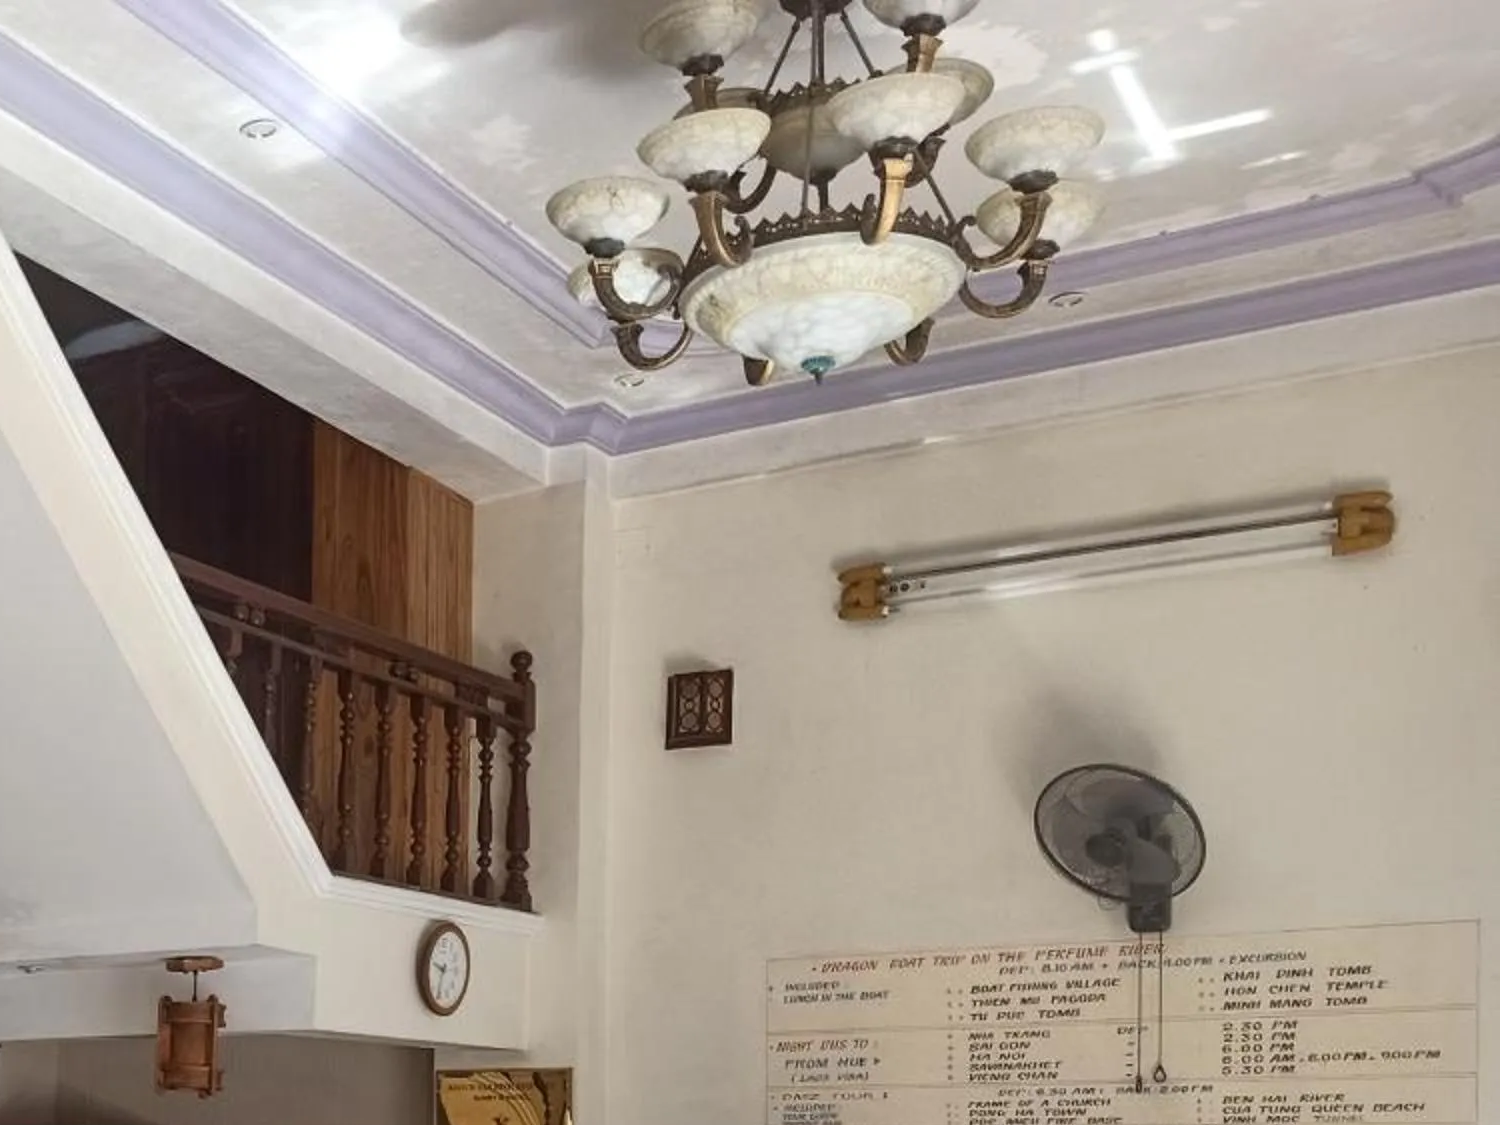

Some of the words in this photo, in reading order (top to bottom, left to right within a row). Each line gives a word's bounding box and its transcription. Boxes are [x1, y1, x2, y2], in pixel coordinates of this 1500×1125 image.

[821, 960, 879, 973] DRAGON
[889, 957, 925, 971] BOAT
[933, 954, 967, 968] TRIP
[971, 952, 991, 966] ON
[998, 949, 1026, 964] THE
[1035, 946, 1109, 962] PERFUME
[1230, 951, 1307, 965] EXCURSION
[1223, 969, 1260, 983] KHAI
[1276, 967, 1314, 980] DINH
[1328, 963, 1373, 978] TOMB
[969, 982, 1007, 996] BOAT
[1065, 977, 1121, 992] VILLAGE
[1225, 985, 1257, 998] HON
[1268, 982, 1311, 996] CHEN
[1327, 978, 1390, 993] TEMPLE
[1051, 992, 1106, 1005] PAGODA
[1223, 999, 1261, 1012] MINH
[1269, 997, 1313, 1010] MANG
[1325, 995, 1368, 1008] TOMB
[1040, 1006, 1082, 1020] TOMB
[1271, 1019, 1298, 1031] PM
[1004, 1029, 1051, 1040] TRANG
[1271, 1031, 1296, 1042] PM
[1270, 1042, 1295, 1053] PM
[785, 1058, 830, 1070] FROM
[837, 1057, 868, 1068] HUE
[1017, 1069, 1059, 1081] CHAN
[834, 1092, 875, 1102] TOUR
[1018, 1100, 1035, 1108] OF
[1041, 1099, 1051, 1108] A
[1057, 1098, 1112, 1108] CHURCH
[1300, 1092, 1345, 1103] RIVER
[1044, 1107, 1088, 1117] TOWN
[1222, 1105, 1252, 1115] CUA
[1311, 1103, 1365, 1114] QUEEN
[1373, 1102, 1426, 1113] BEACH
